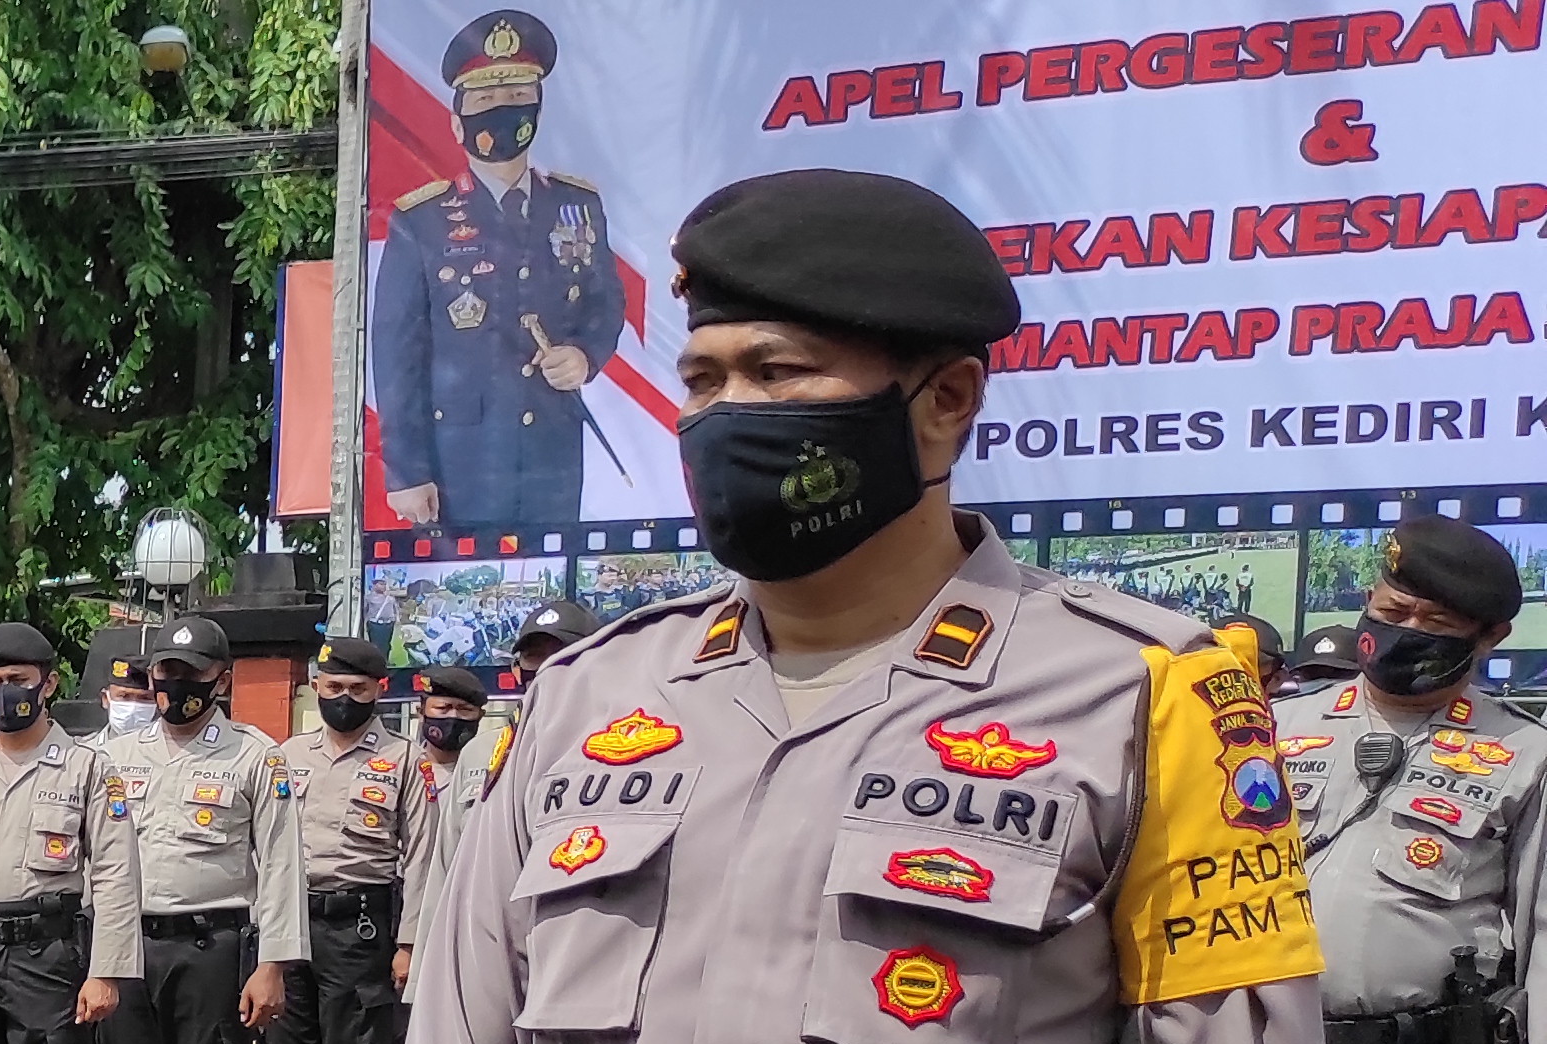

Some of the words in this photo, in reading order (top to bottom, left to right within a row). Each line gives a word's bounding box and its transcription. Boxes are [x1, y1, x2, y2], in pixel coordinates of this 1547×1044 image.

[763, 62, 962, 131] APEL
[977, 0, 1546, 105] PERGESERAN
[1301, 100, 1378, 164] &
[990, 307, 1279, 373] MANTAP
[1289, 292, 1534, 356] PRAJA
[976, 411, 1225, 460] POLRES
[1249, 398, 1486, 448] KEDIRI
[789, 499, 864, 540] POLRI
[544, 770, 684, 811] RUDI
[854, 771, 1060, 841] POLRI
[1408, 770, 1493, 803] POLRI
[1163, 895, 1280, 955] PAM
